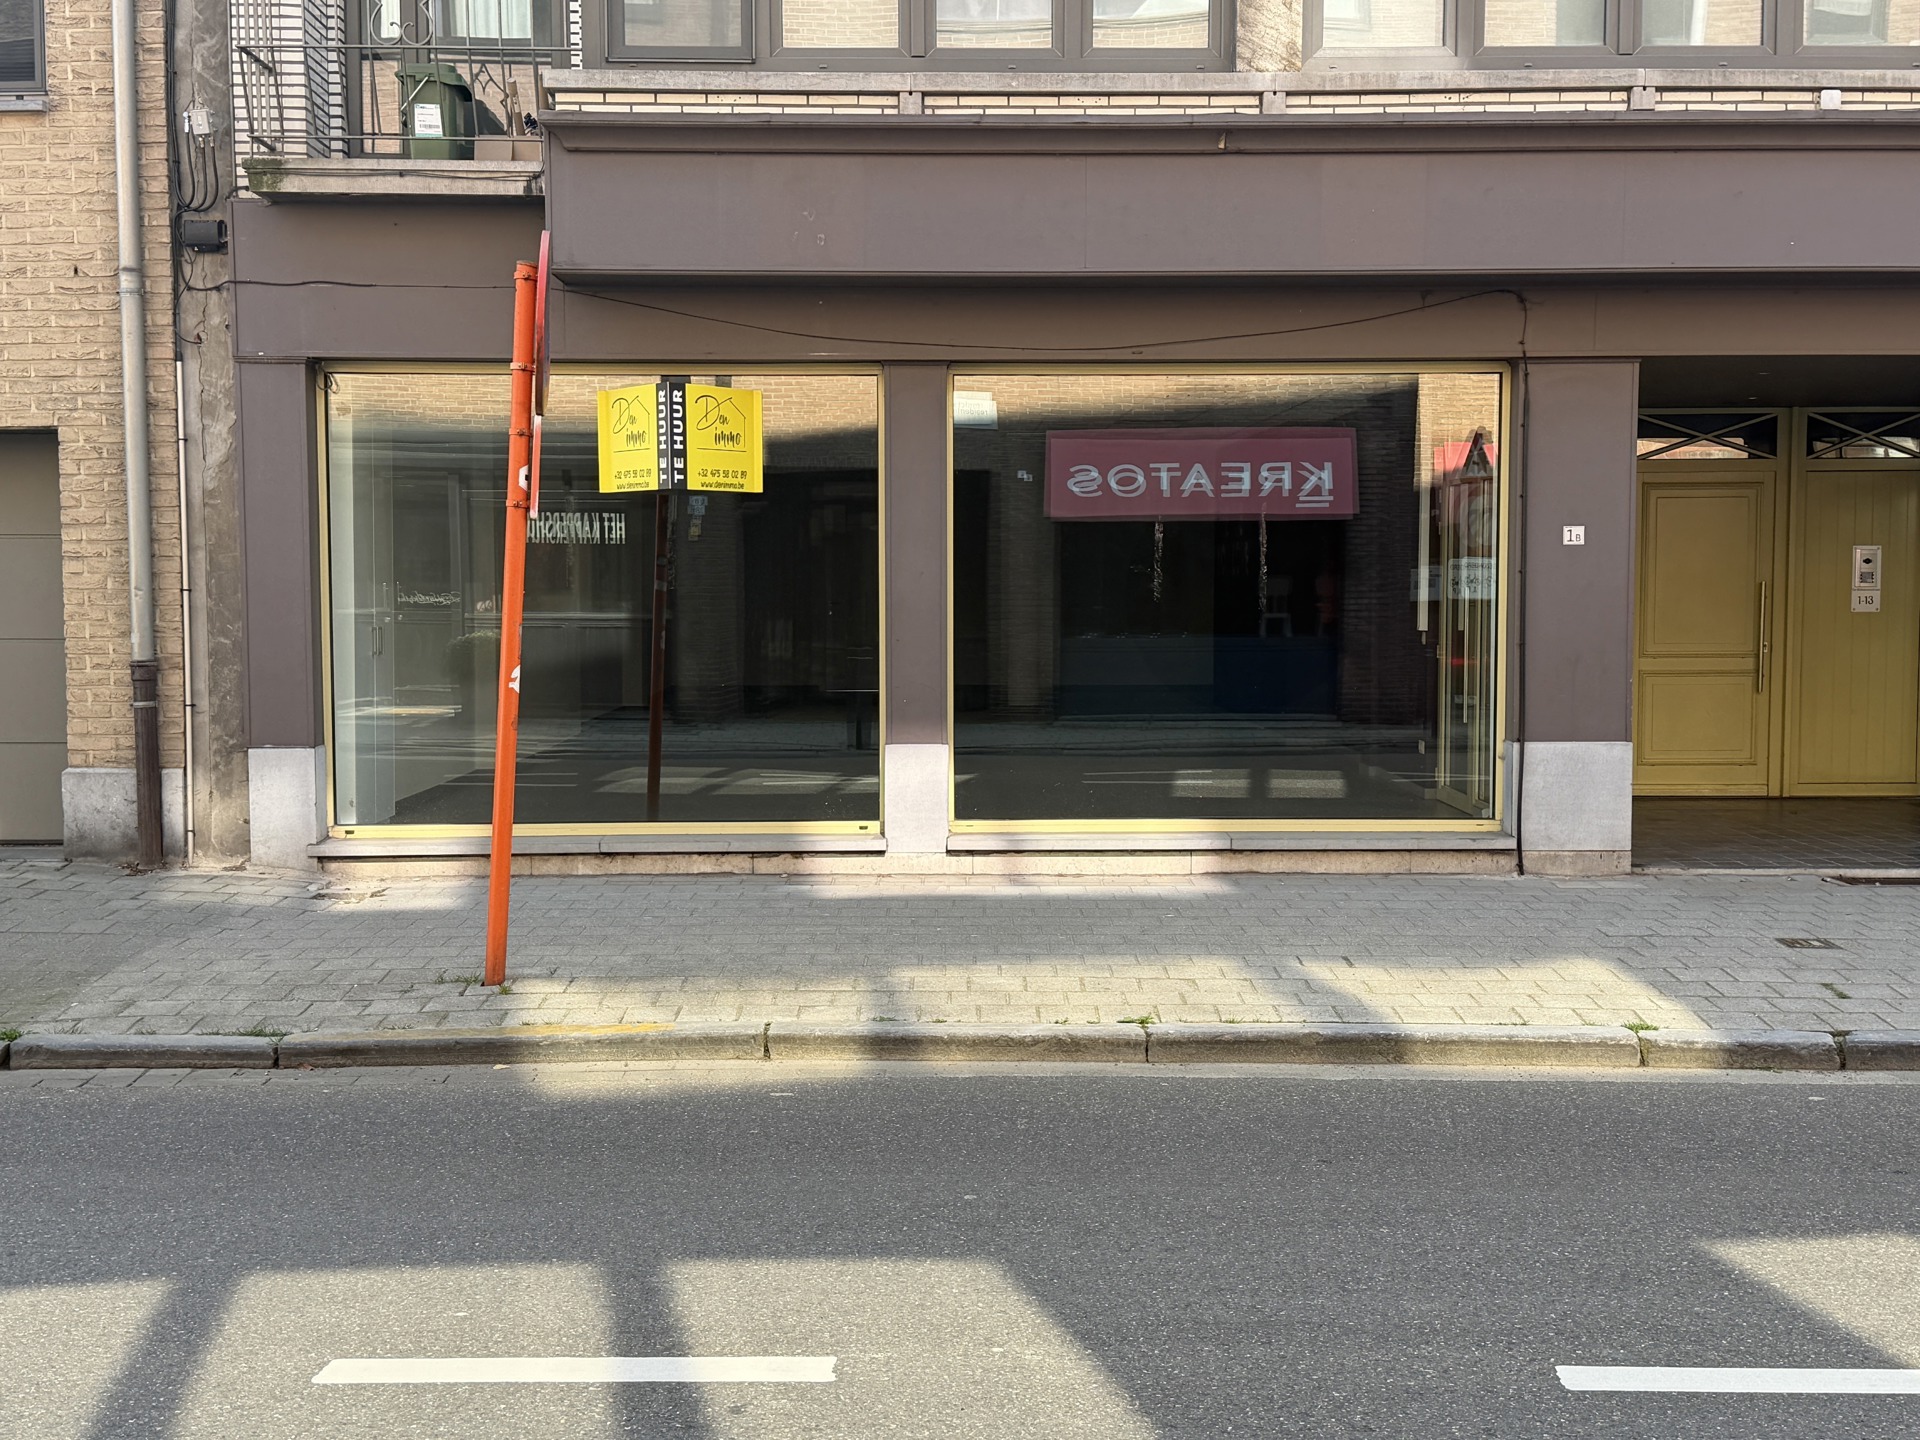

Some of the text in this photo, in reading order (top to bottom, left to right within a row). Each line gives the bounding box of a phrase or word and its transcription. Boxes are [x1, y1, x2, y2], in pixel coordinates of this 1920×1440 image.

[695, 394, 732, 430] Den
[658, 390, 668, 484] TE HUUR
[672, 390, 684, 484] TE HUUR
[714, 426, 742, 448] immo
[698, 468, 708, 477] +32
[710, 469, 721, 478] 475
[722, 470, 730, 478] 58
[731, 470, 739, 479] 02
[1858, 596, 1874, 604] 1-13
